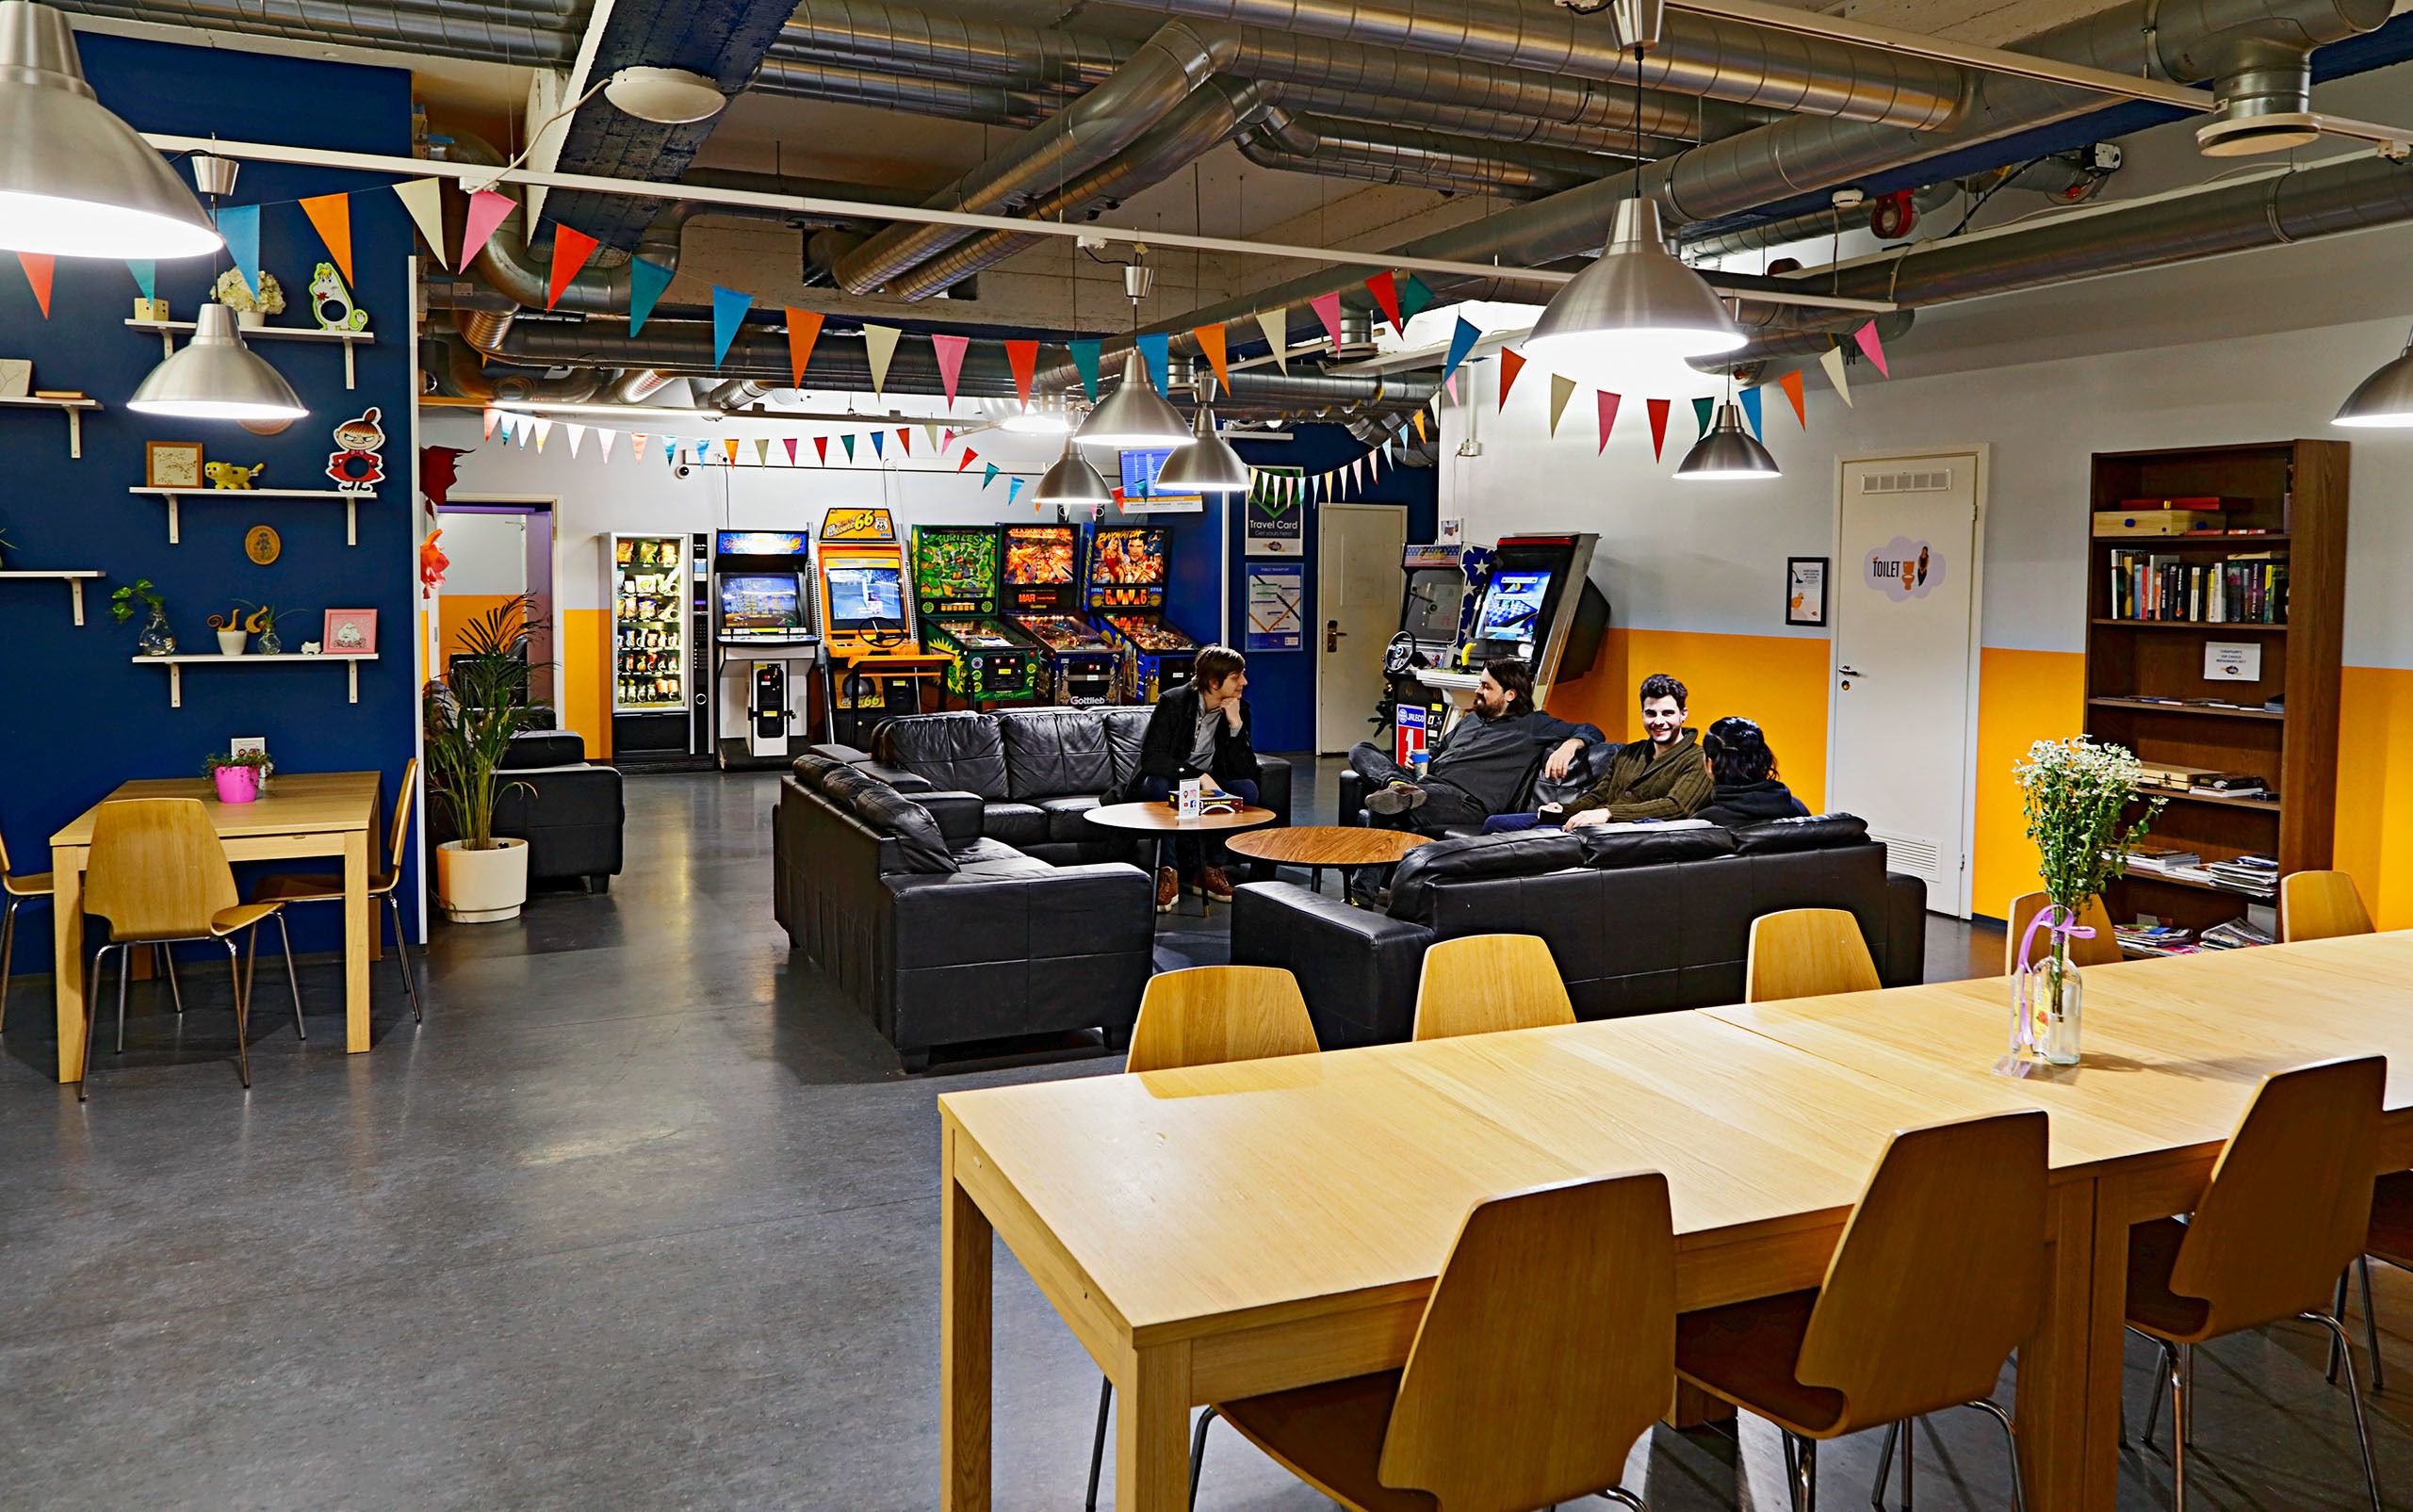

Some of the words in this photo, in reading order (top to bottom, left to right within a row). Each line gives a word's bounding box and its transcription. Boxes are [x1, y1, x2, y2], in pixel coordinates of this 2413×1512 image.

[855, 510, 874, 530] 66
[1249, 519, 1275, 528] Travel
[1277, 520, 1298, 529] Card
[935, 534, 980, 545] TURTLES
[1096, 529, 1147, 542] BAYWATCH
[1872, 561, 1900, 577] TOILET
[1070, 695, 1105, 705] Gottlieb
